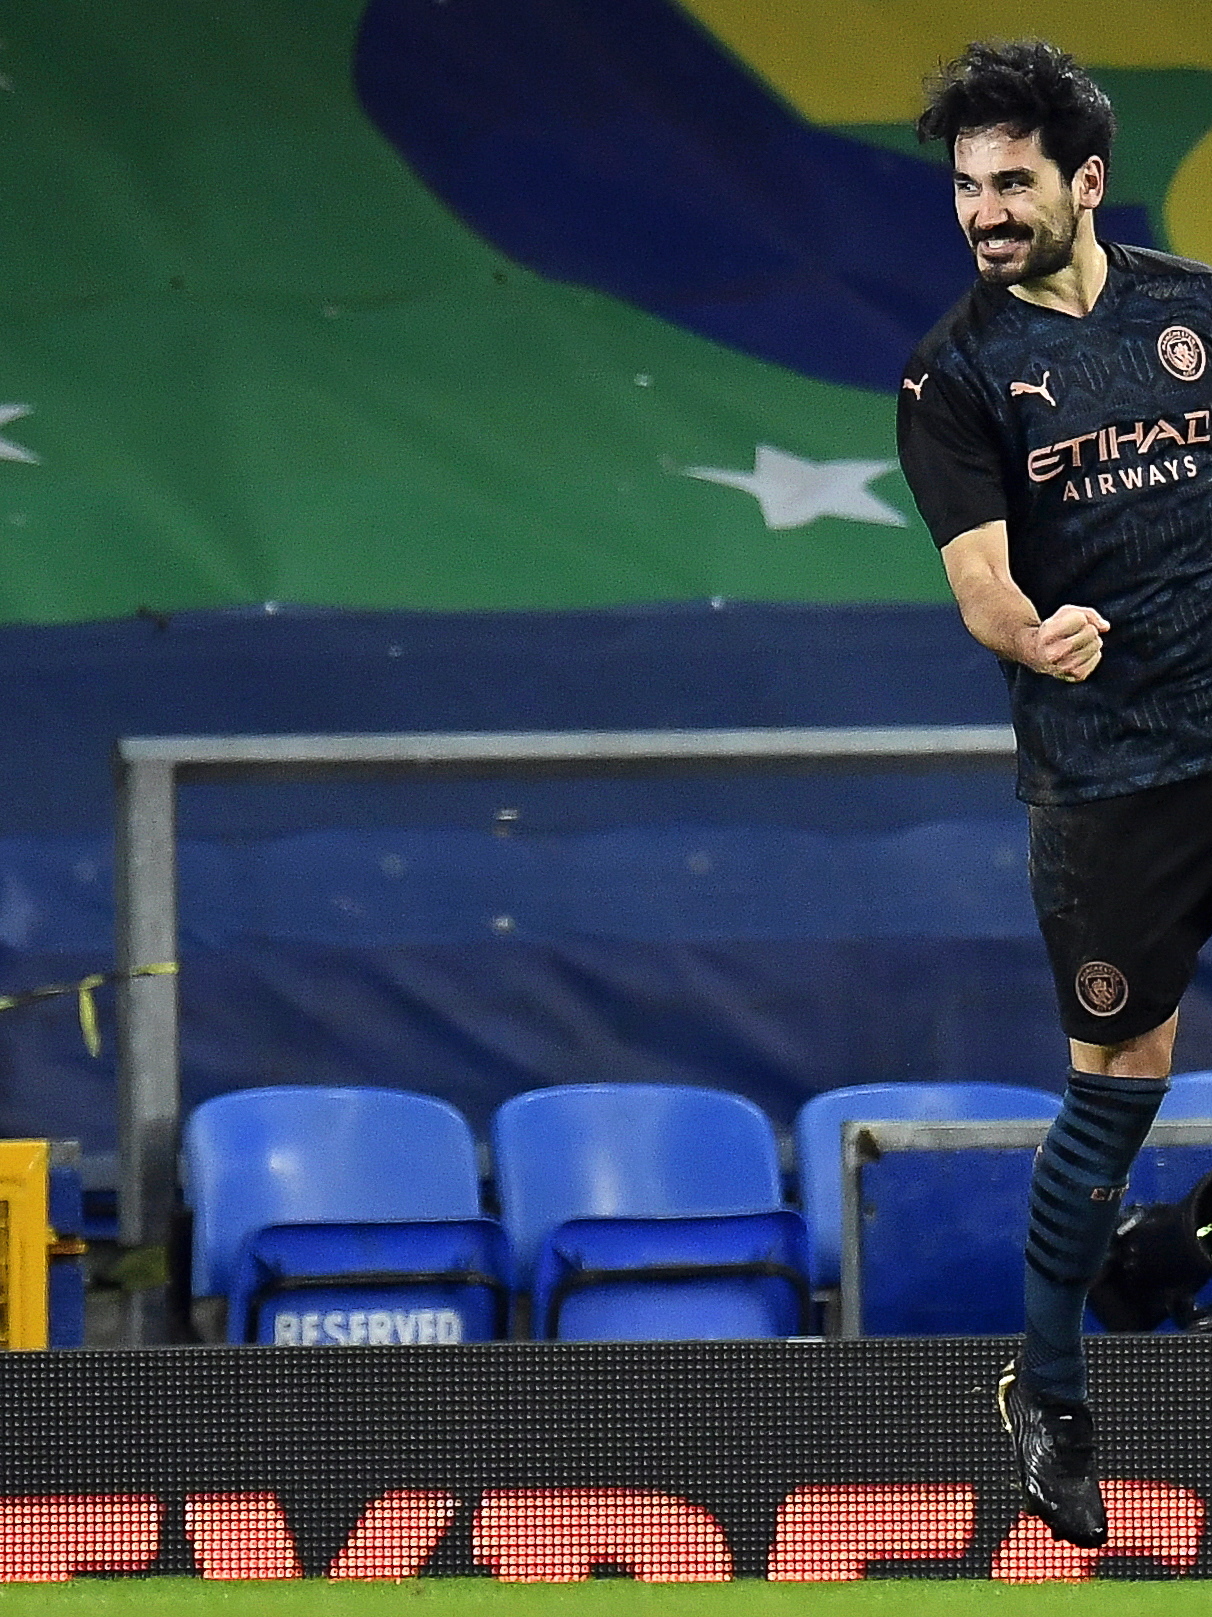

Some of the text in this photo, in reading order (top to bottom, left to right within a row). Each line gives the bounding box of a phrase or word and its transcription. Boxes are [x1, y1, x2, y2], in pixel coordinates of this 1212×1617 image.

[1028, 410, 1211, 483] ETIHAD
[1063, 455, 1198, 502] AIRWAYS
[275, 1308, 463, 1345] RESERVED
